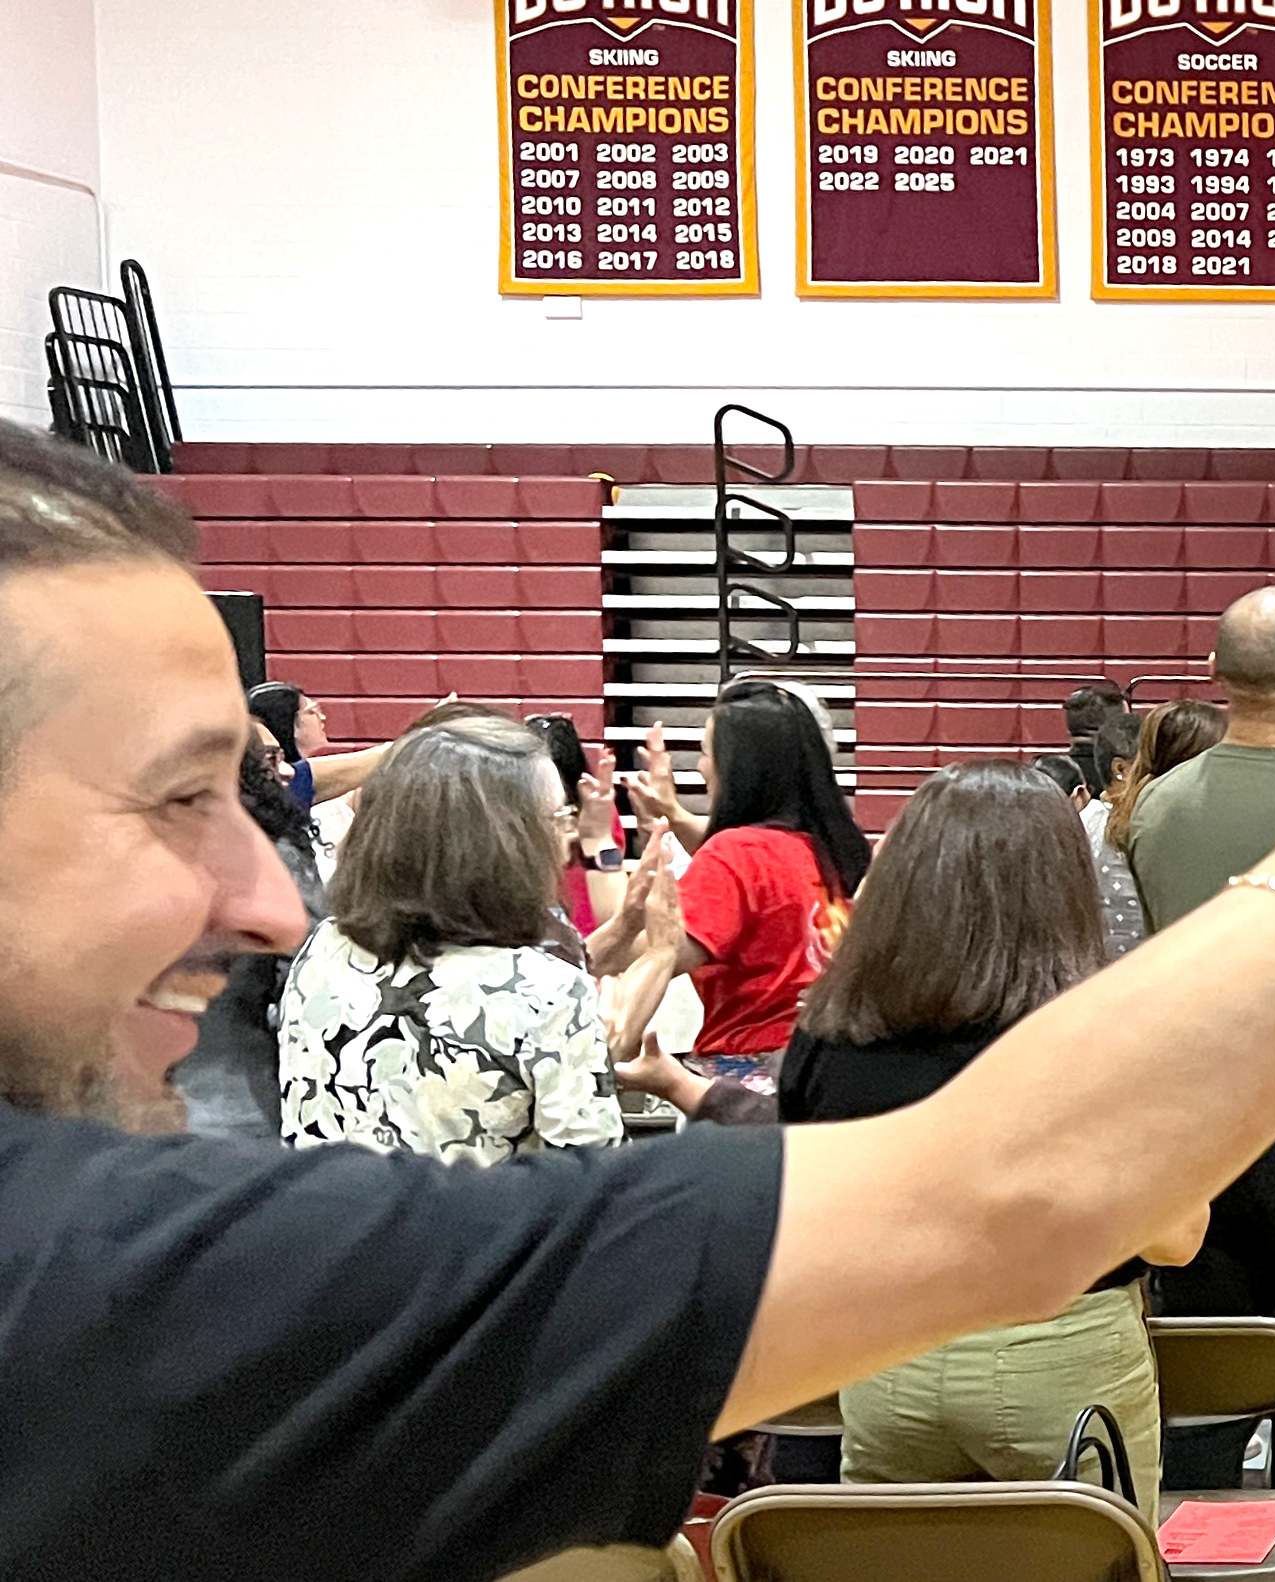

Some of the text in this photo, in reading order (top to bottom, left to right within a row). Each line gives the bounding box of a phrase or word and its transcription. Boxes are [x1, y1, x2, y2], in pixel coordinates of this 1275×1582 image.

[588, 48, 659, 66] SKIING
[887, 49, 957, 67] SKIING
[1177, 53, 1258, 71] SOCCER
[517, 74, 730, 101] CONFERENCE
[816, 76, 1029, 102] CONFERENCE
[518, 105, 730, 135] CHAMPIONS
[817, 107, 1028, 135] CHAMPIONS
[519, 141, 729, 164] 2001 2002 2003
[818, 144, 1028, 166] 2019 2020 2021
[1115, 147, 1175, 167] 1973
[1190, 148, 1250, 168] 1974
[520, 168, 730, 190] 2007 2008 2009
[818, 171, 955, 192] 2022 2025
[1115, 174, 1175, 194] 1993
[1190, 175, 1250, 195] 1994
[521, 195, 731, 217] 2010 2011 2012
[1116, 201, 1176, 221] 2004
[1190, 202, 1250, 221] 2007
[522, 222, 733, 244] 2013 2014 2015
[1116, 227, 1176, 248] 2009
[1191, 228, 1252, 249] 2014
[522, 249, 735, 271] 2016 2017 2018
[1116, 255, 1250, 276] 2018 2021
